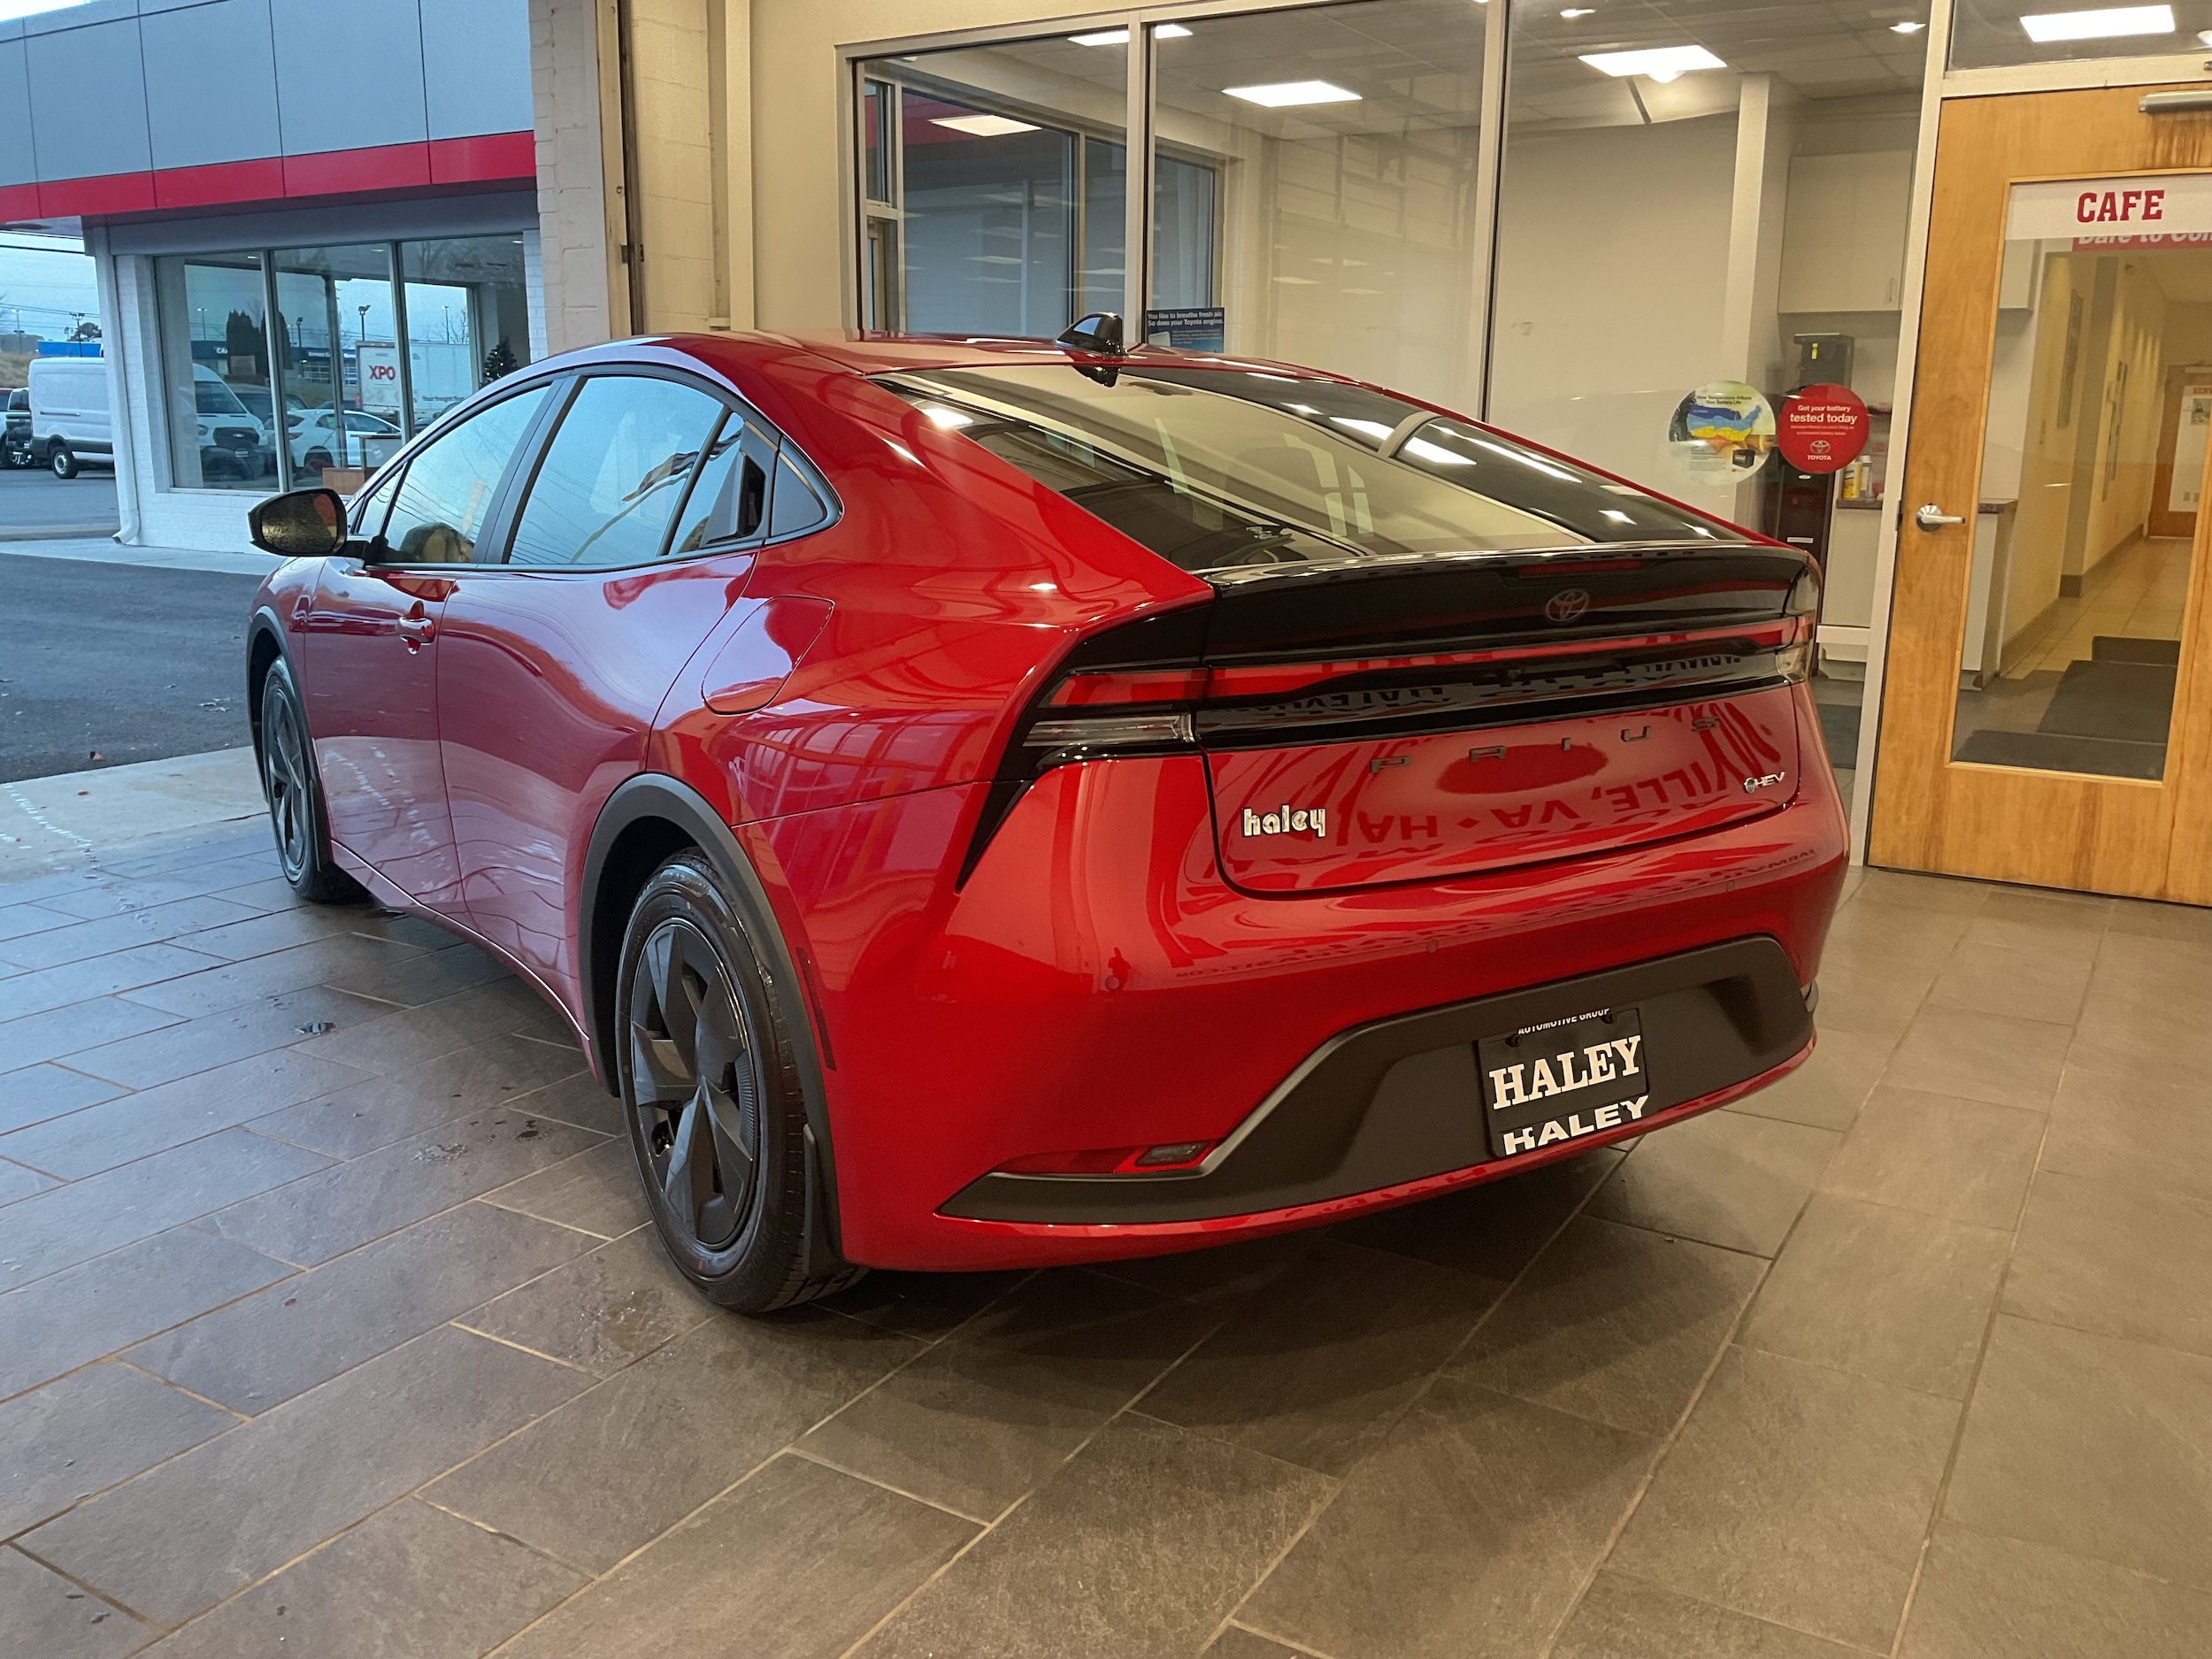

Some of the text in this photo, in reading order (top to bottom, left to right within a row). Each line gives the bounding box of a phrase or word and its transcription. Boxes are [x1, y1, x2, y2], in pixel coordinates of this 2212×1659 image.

[2077, 190, 2164, 222] CAFE
[368, 365, 396, 380] XPO
[1789, 413, 1858, 426] tested today
[1243, 804, 1325, 837] haley
[1517, 1008, 1610, 1034] AUTOMOTIVE GROUP
[1488, 1034, 1641, 1110] HALEY
[1502, 1094, 1649, 1156] HALEY
